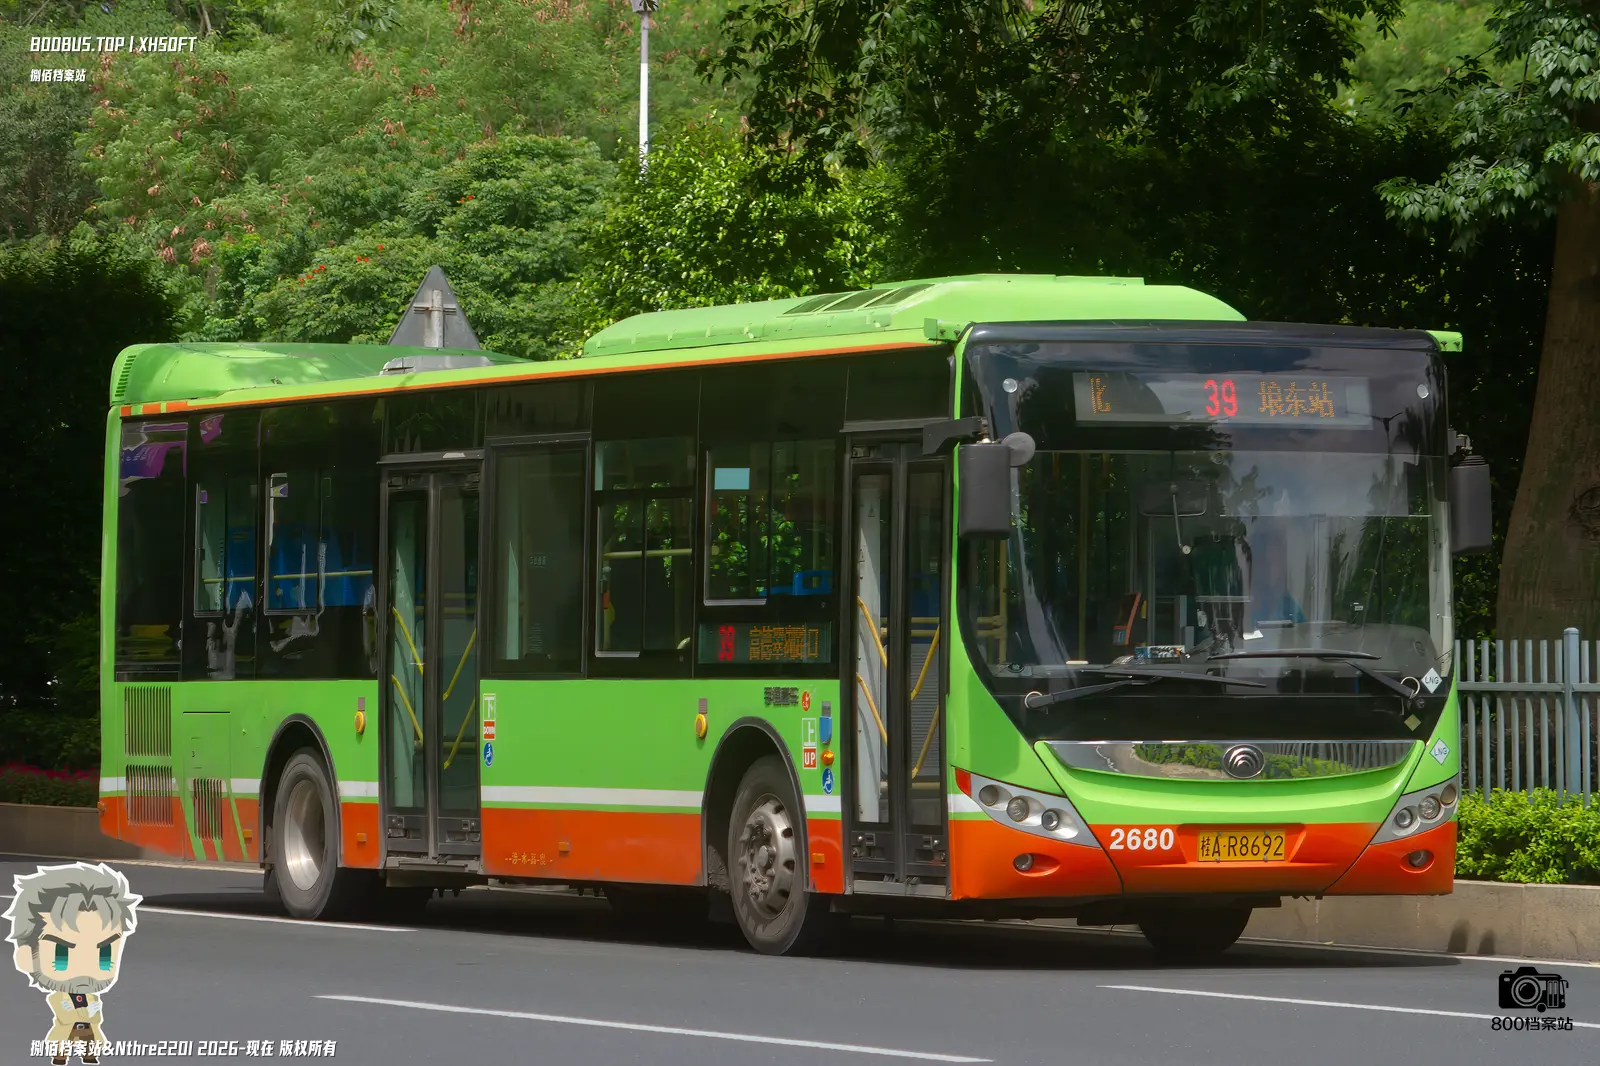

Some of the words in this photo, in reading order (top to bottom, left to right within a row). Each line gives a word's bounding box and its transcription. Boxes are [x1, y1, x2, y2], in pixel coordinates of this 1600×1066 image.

[1203, 379, 1237, 417] 39
[1257, 380, 1335, 418] 埌东站
[1424, 676, 1439, 685] LNG
[484, 696, 495, 718] 下
[803, 721, 816, 747] 上
[804, 751, 816, 766] UP
[1433, 746, 1447, 757] LNG
[1109, 828, 1174, 850] 2680
[1200, 835, 1284, 858] 桂A·R8692
